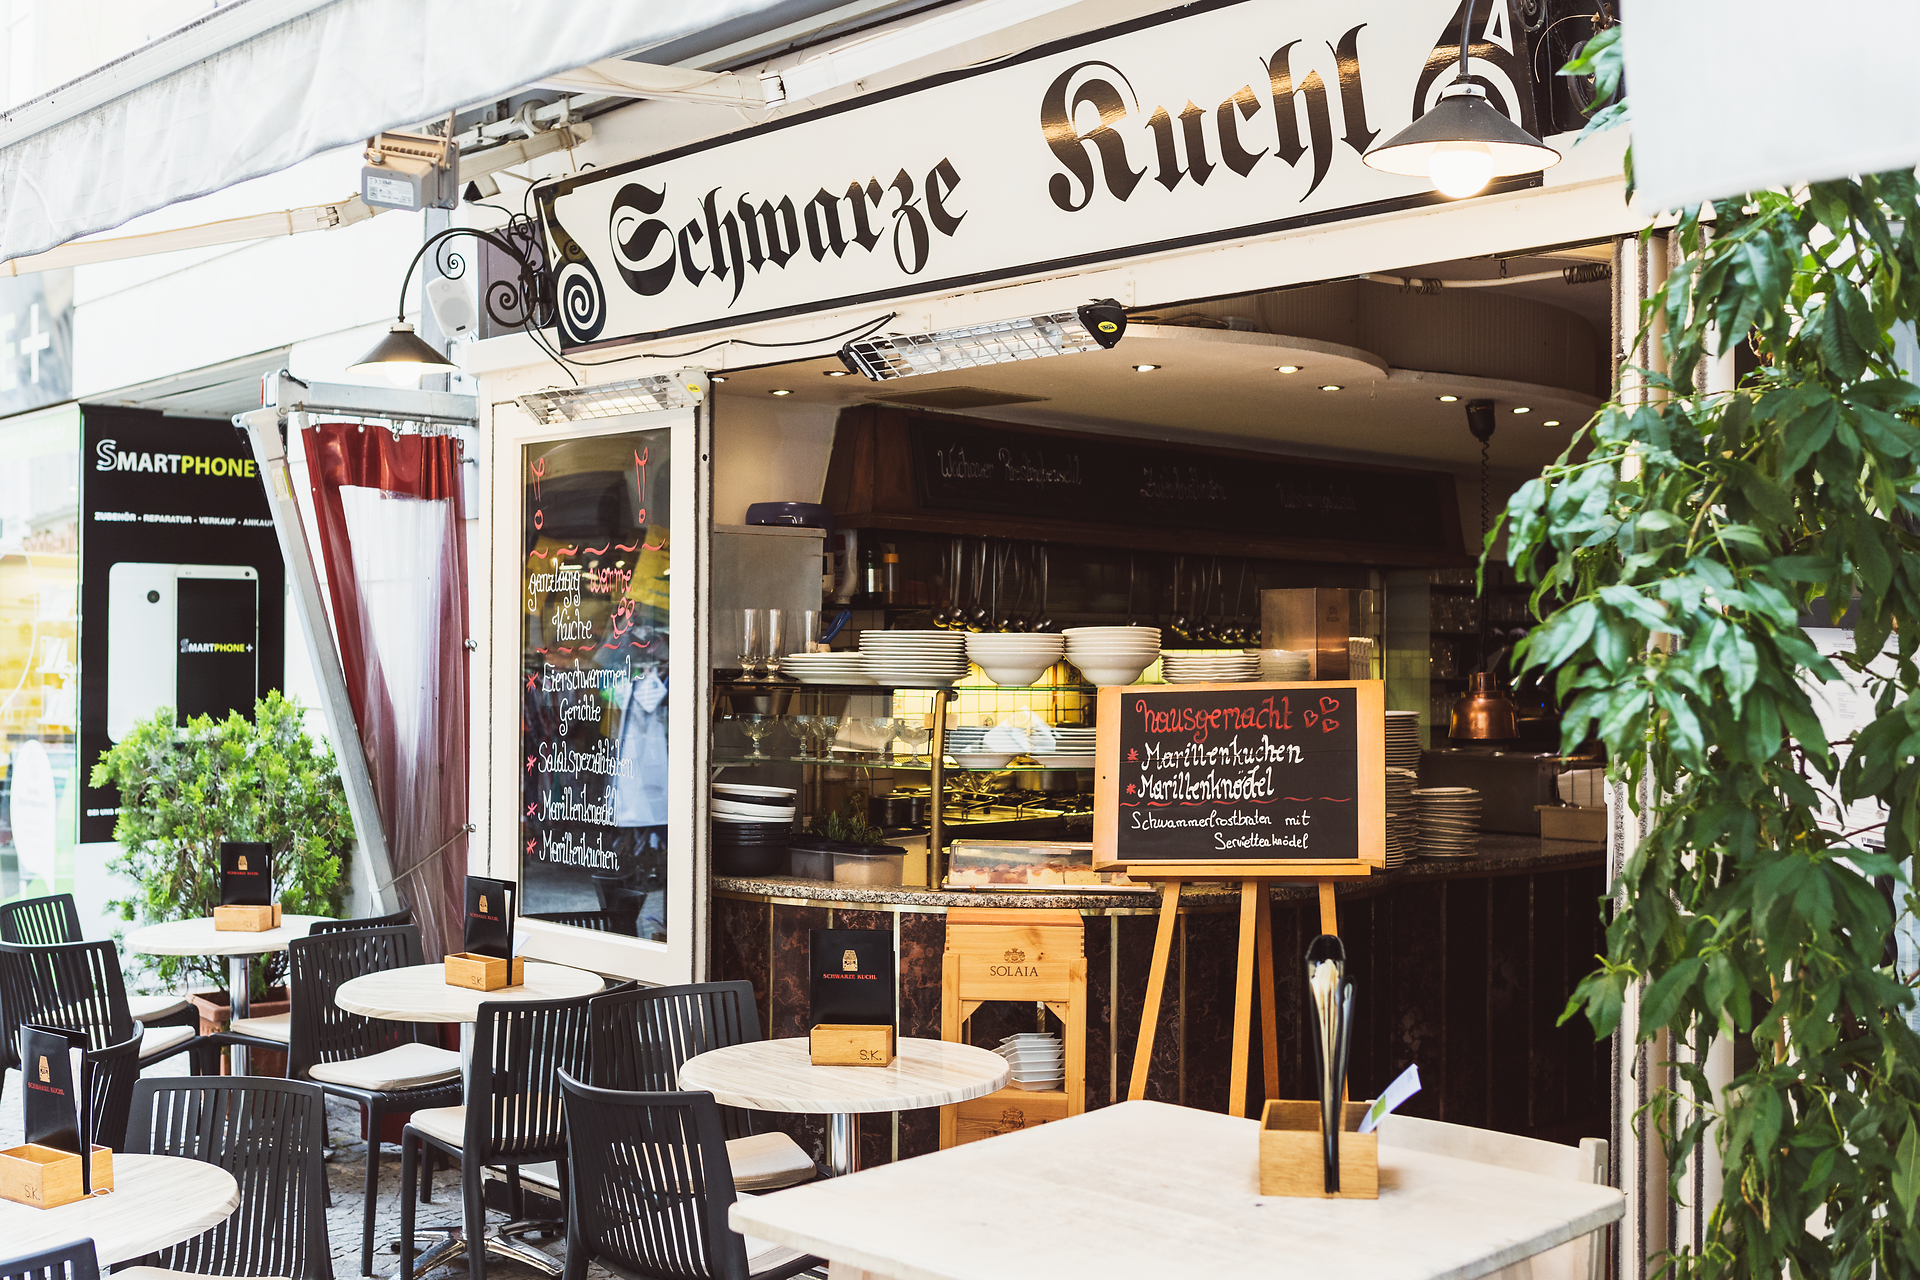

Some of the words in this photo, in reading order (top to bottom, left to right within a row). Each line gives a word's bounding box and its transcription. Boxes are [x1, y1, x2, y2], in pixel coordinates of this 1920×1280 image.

[608, 155, 968, 310] Schwarze
[1038, 22, 1381, 213] Kuchl
[94, 511, 137, 522] ZUBEHÖR
[142, 514, 192, 524] REPARATUR
[198, 516, 236, 526] VERKAUF
[589, 567, 632, 594] warme
[558, 693, 601, 737] Gerichte
[1135, 695, 1294, 744] hausgemacht
[1141, 733, 1305, 771] Marillenkuchen
[1137, 764, 1275, 801] Marillenknödel
[1285, 809, 1311, 827] mit
[989, 965, 1039, 977] SOLAIA
[859, 1049, 882, 1061] S.K.
[24, 1184, 41, 1201] S.K.
